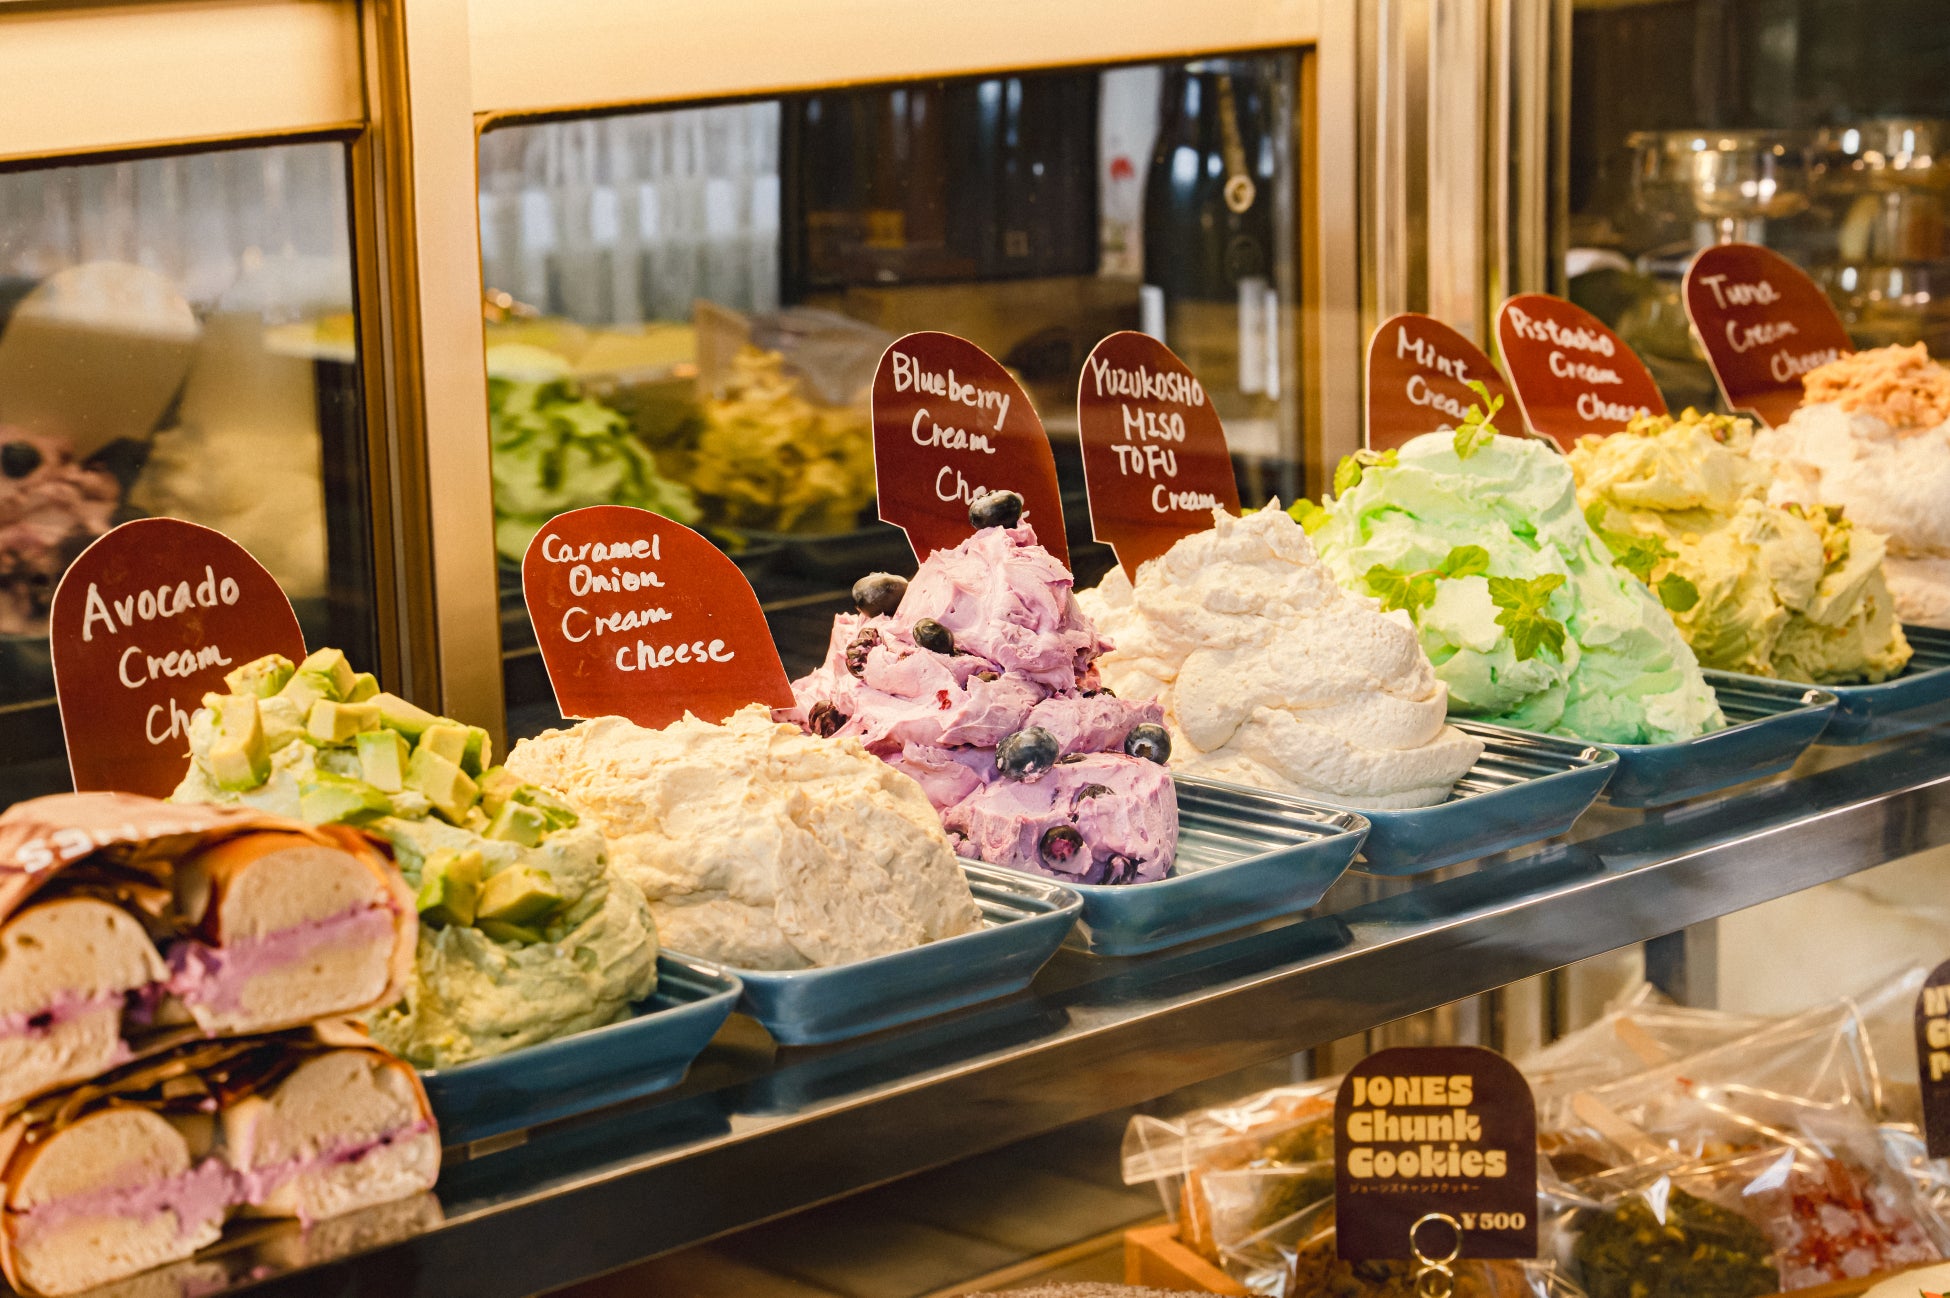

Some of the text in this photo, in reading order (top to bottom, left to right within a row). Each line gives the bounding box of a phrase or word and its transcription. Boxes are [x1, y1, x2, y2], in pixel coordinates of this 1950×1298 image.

[1698, 273, 1781, 310] Tuna
[1725, 319, 1799, 353] Cream
[1397, 325, 1473, 385] Mint
[1549, 350, 1624, 384] Cream
[892, 351, 1011, 431] Blueberry
[1406, 374, 1471, 419] Crea
[911, 408, 996, 454] Cream
[1121, 403, 1186, 443] MISO
[1111, 445, 1178, 479] TOFU
[1152, 484, 1225, 513] Cream
[542, 533, 661, 563] Caramel
[569, 564, 665, 596] Onion
[82, 565, 240, 642] Avocado
[561, 607, 673, 643] Cream
[119, 645, 232, 688] Cream
[1352, 1075, 1474, 1107] JONES
[1347, 1108, 1482, 1143] Chunk
[1348, 1142, 1507, 1178] Cookies
[1459, 1212, 1527, 1230] ¥500
